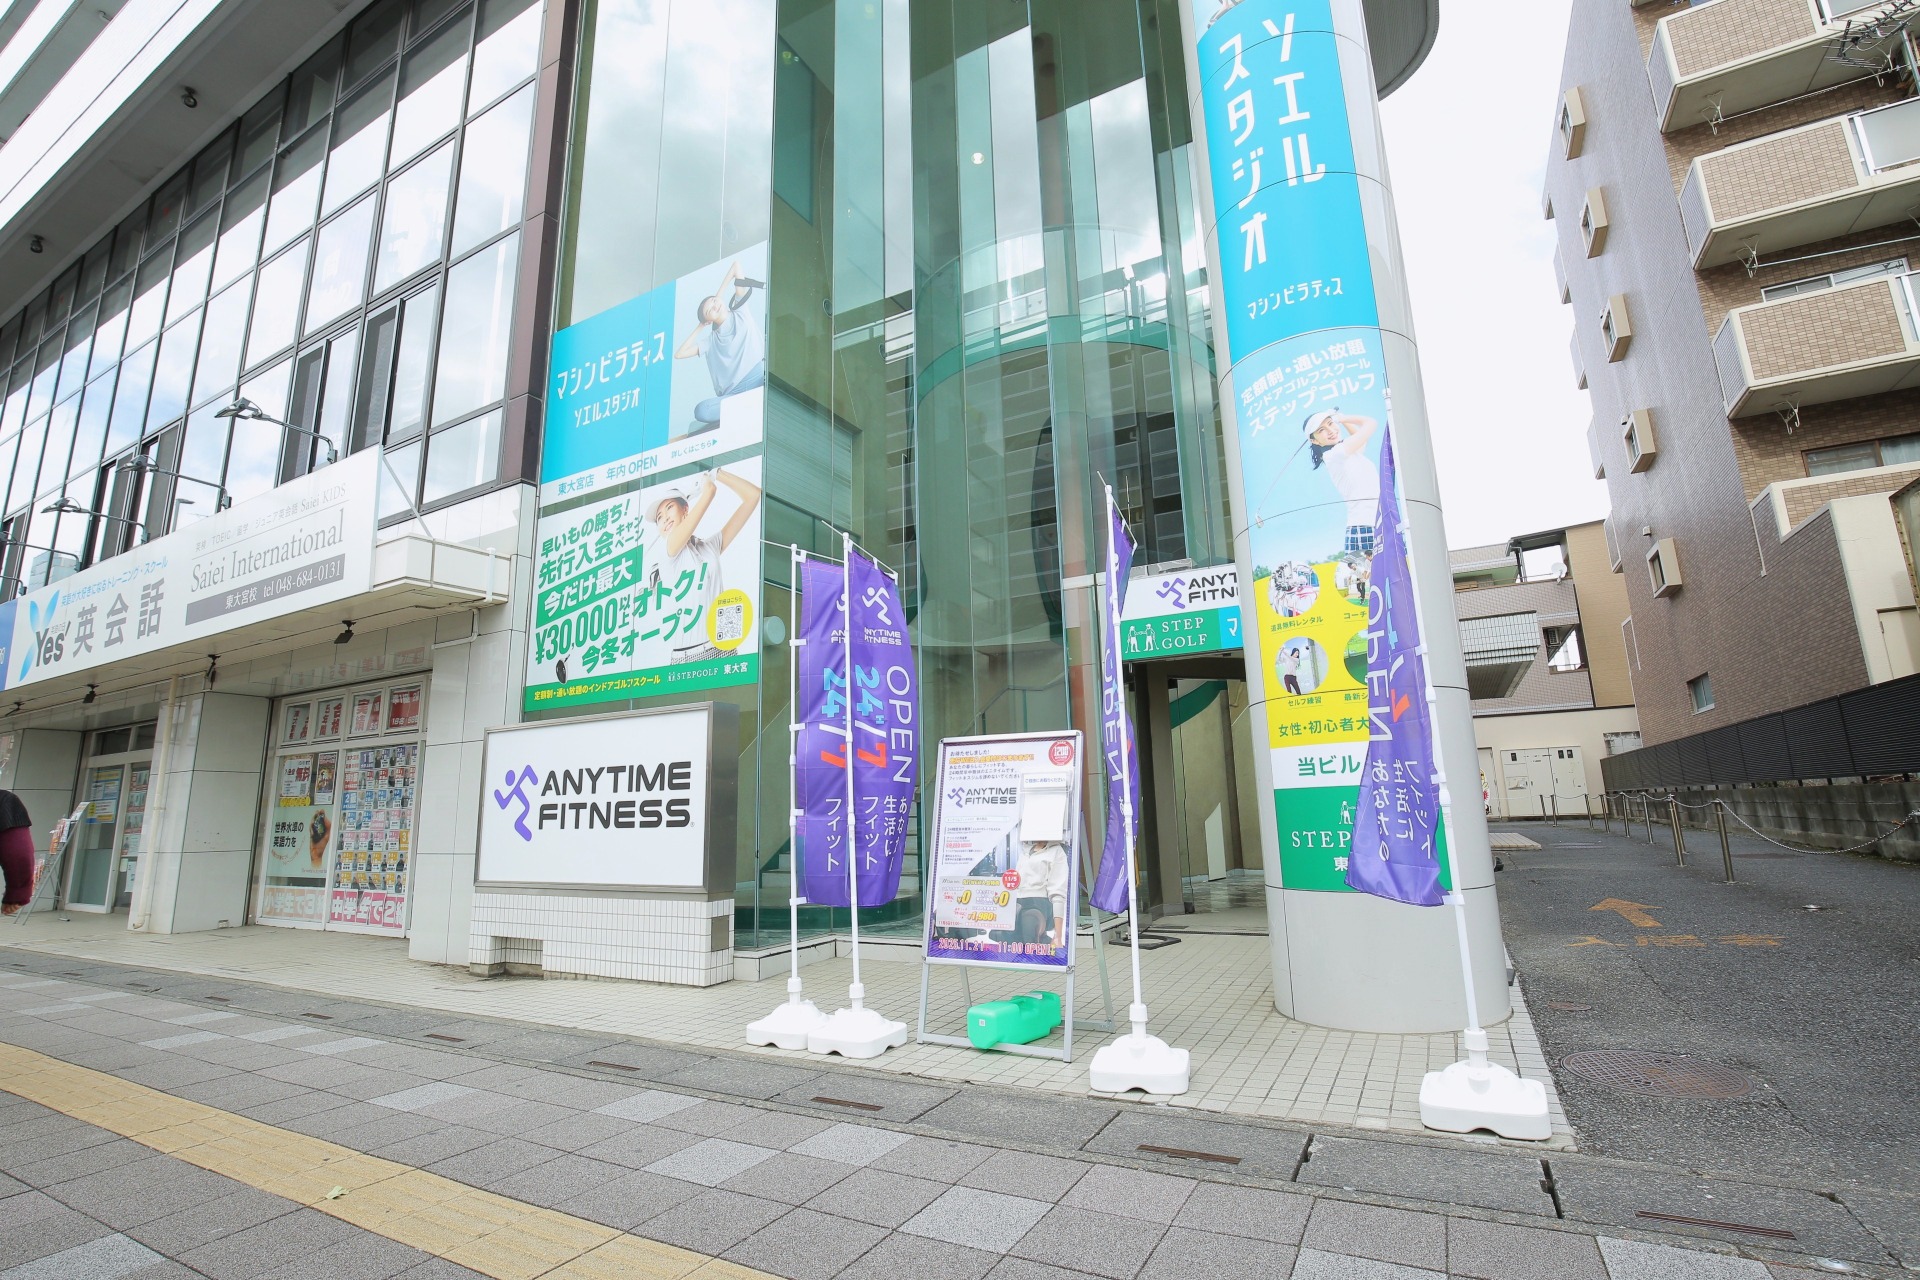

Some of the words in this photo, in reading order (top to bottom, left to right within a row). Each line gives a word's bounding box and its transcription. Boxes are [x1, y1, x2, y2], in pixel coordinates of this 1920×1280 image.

[1262, 12, 1326, 187] ソエル
[1219, 33, 1268, 273] スタジオ
[1247, 277, 1344, 320] マシンピラティス
[556, 331, 666, 400] マシンピラティス
[1241, 338, 1367, 405] 定額制・通い放題
[574, 387, 641, 428] ソエルスタジオ
[1245, 358, 1371, 418] インドアゴルフスクール
[1249, 372, 1376, 438] ステップゴルフ
[671, 439, 713, 459] 詳しくはこちら
[557, 473, 595, 496] 東大宮店
[606, 463, 626, 481] 年内
[628, 454, 658, 475] OPEN
[300, 496, 320, 513] Saiei
[322, 482, 347, 504] KIDS
[614, 529, 645, 549] ペーン
[615, 515, 644, 537] キャン
[190, 557, 226, 593] Saiei
[230, 507, 345, 580] International
[538, 531, 615, 590] 先行入会
[225, 586, 258, 610] 東大宮校
[263, 580, 274, 598] tel
[275, 559, 341, 596] 048-684-0131
[543, 557, 633, 617] 今だけ最大
[73, 577, 165, 658] 英会話
[1161, 617, 1204, 633] STEP
[1270, 615, 1324, 632] 道具無料レンタル
[581, 604, 704, 674] 今冬オープン
[1161, 634, 1208, 650] GOLF
[723, 661, 749, 675] 東大宮
[1287, 696, 1322, 707] セルフ練習
[886, 665, 913, 784] OPEN
[540, 761, 692, 796] ANYTIME
[1297, 754, 1361, 777] 当ビル
[965, 796, 1017, 805] FITNESS
[966, 787, 1017, 796] ANYTIME
[274, 821, 304, 834] 世界水準の
[538, 798, 691, 830] FITNESS
[825, 798, 842, 872] フィット
[862, 796, 880, 870] フィット
[883, 794, 898, 857] 生活に
[273, 836, 297, 848] 英語力を
